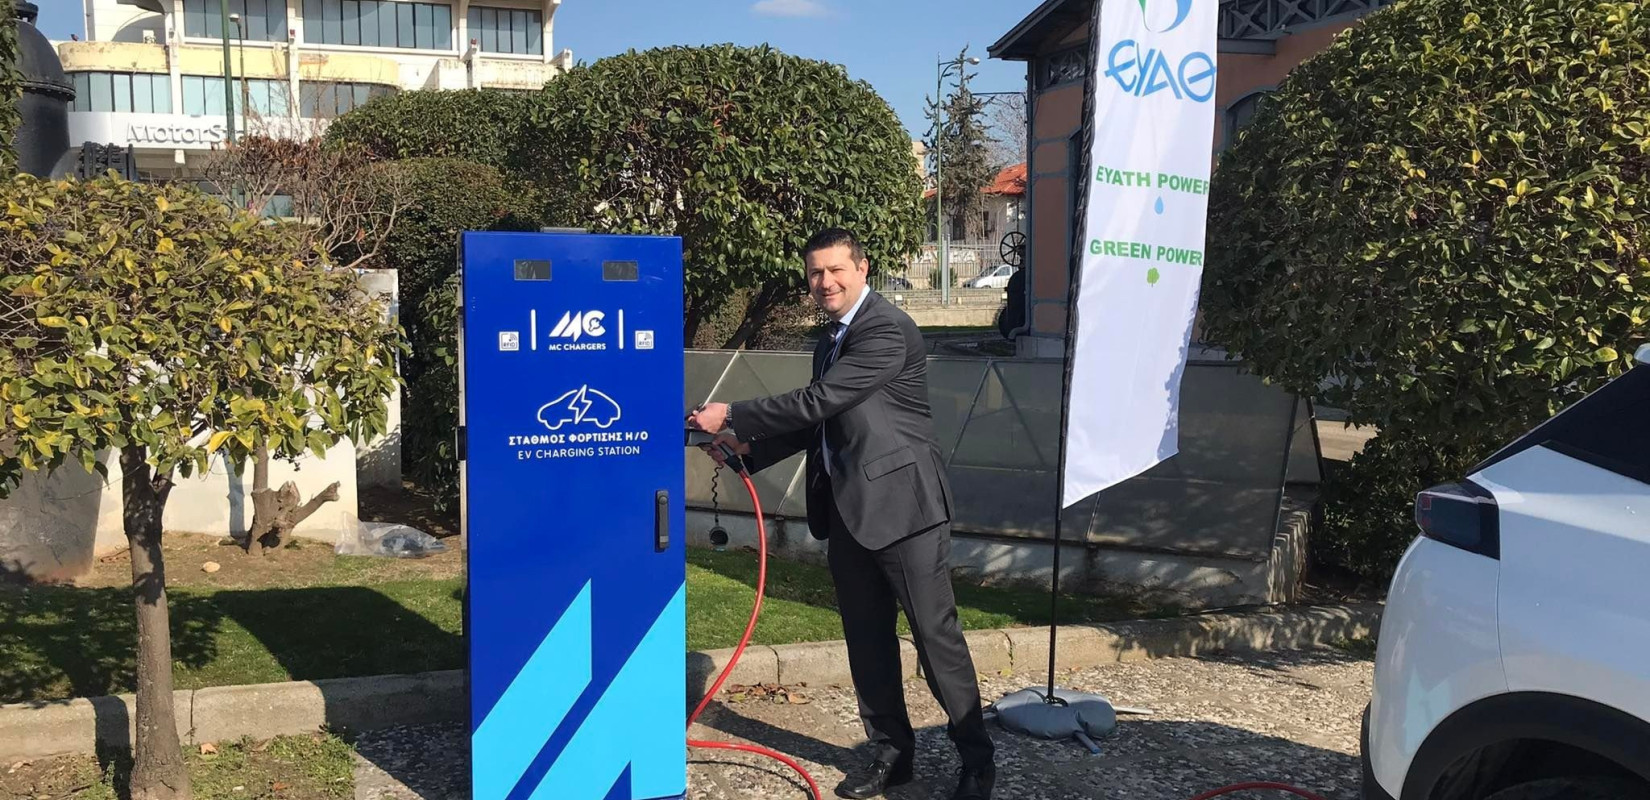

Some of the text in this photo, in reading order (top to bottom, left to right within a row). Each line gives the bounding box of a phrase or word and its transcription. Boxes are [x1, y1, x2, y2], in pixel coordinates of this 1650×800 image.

[1096, 165, 1150, 187] EYATH
[1089, 239, 1203, 266] GREEN POWER
[563, 343, 607, 351] CHARGERS
[508, 434, 566, 446] ΣΤΑΘΜΟΣ
[568, 432, 623, 444] ΦΟΡΤΙΣΗΣ
[518, 446, 640, 460] EV CHARGING STATION
